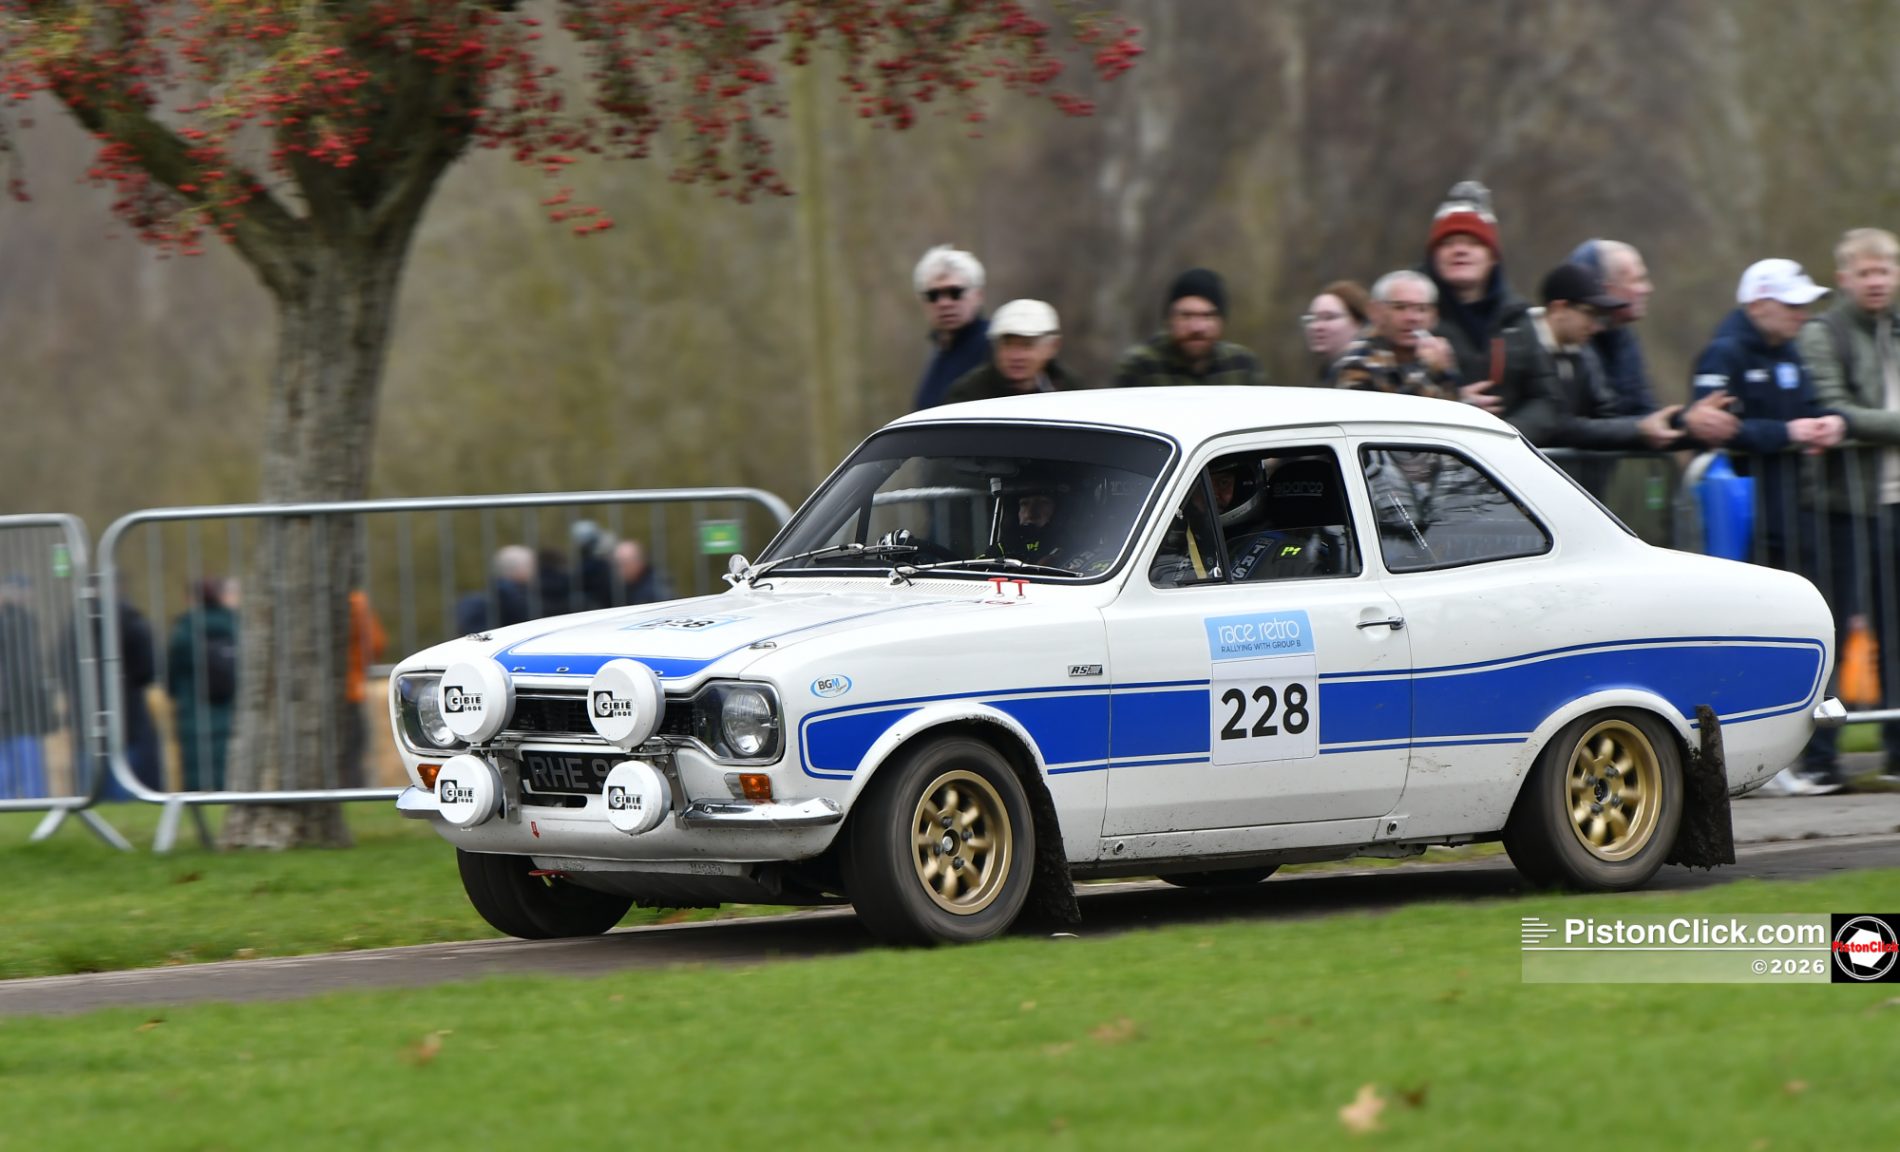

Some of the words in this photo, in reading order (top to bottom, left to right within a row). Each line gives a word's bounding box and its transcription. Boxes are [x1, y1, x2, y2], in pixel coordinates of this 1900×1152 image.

[1232, 544, 1266, 579] TRS
[1218, 623, 1257, 643] race
[1258, 617, 1300, 641] retro
[1221, 643, 1253, 653] RALLYING
[1253, 642, 1271, 651] WITH
[1272, 640, 1296, 649] GROUP
[1296, 639, 1302, 648] B
[817, 678, 841, 691] BGM
[1220, 683, 1310, 741] 228
[528, 756, 589, 789] RHE
[591, 758, 625, 789] 9
